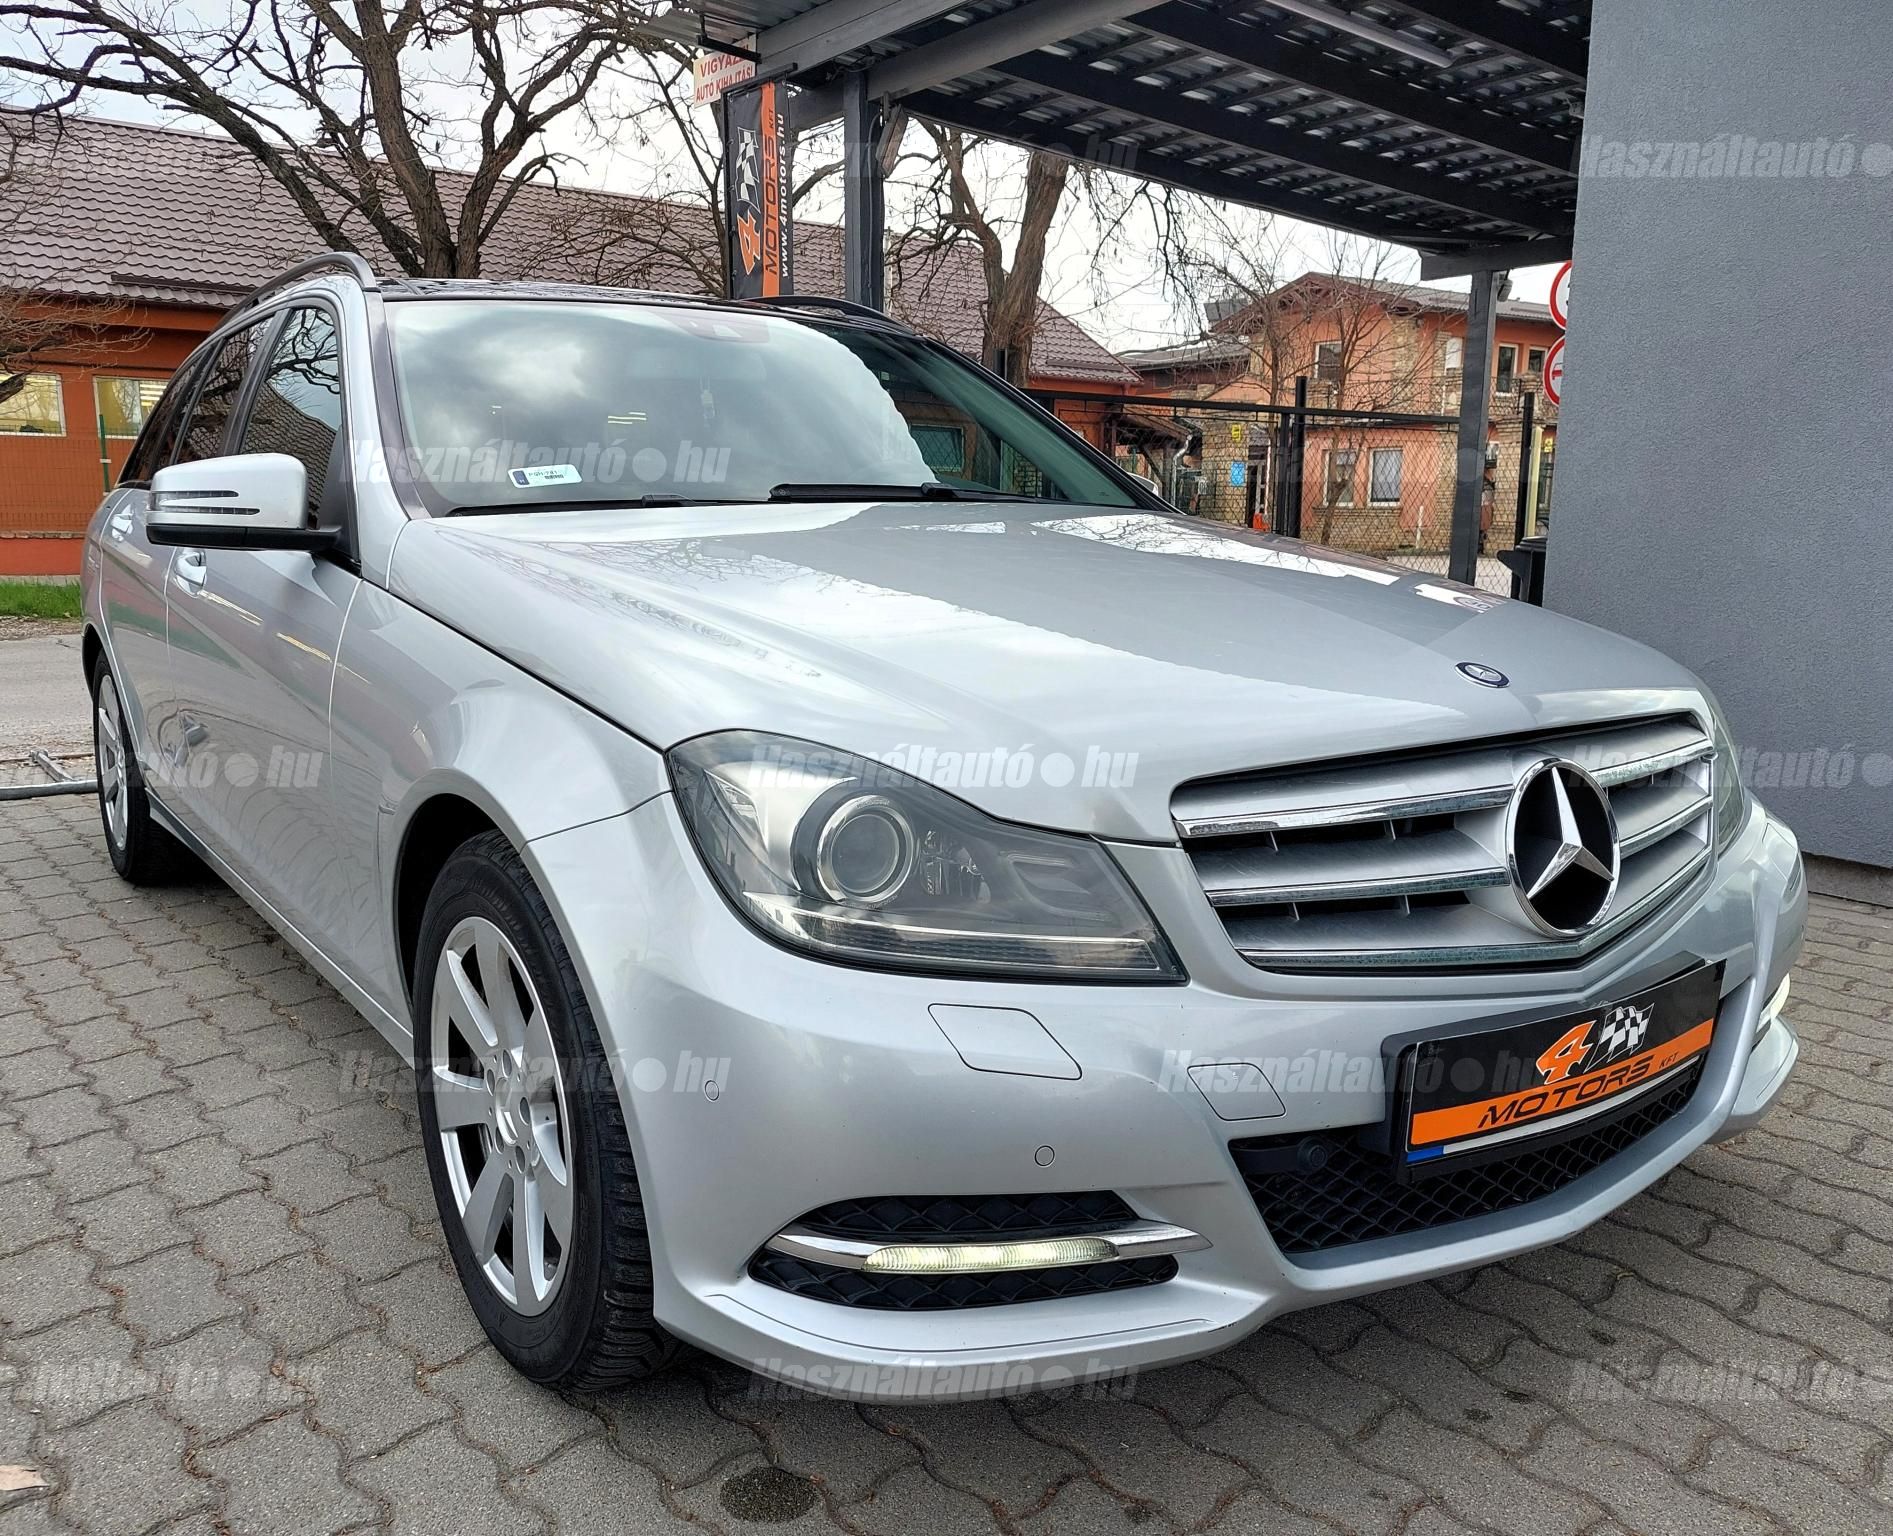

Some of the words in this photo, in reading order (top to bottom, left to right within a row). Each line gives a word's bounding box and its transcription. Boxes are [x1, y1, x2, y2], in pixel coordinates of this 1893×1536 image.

[695, 78, 714, 102] AUTÓ
[768, 108, 776, 129] KFT
[763, 134, 778, 275] MOTORS
[776, 114, 789, 277] www.4motors.hu
[736, 209, 761, 275] 4
[1535, 1019, 1597, 1085] 4
[1477, 1054, 1656, 1129] MOTORS
[1658, 1051, 1679, 1071] KFT
